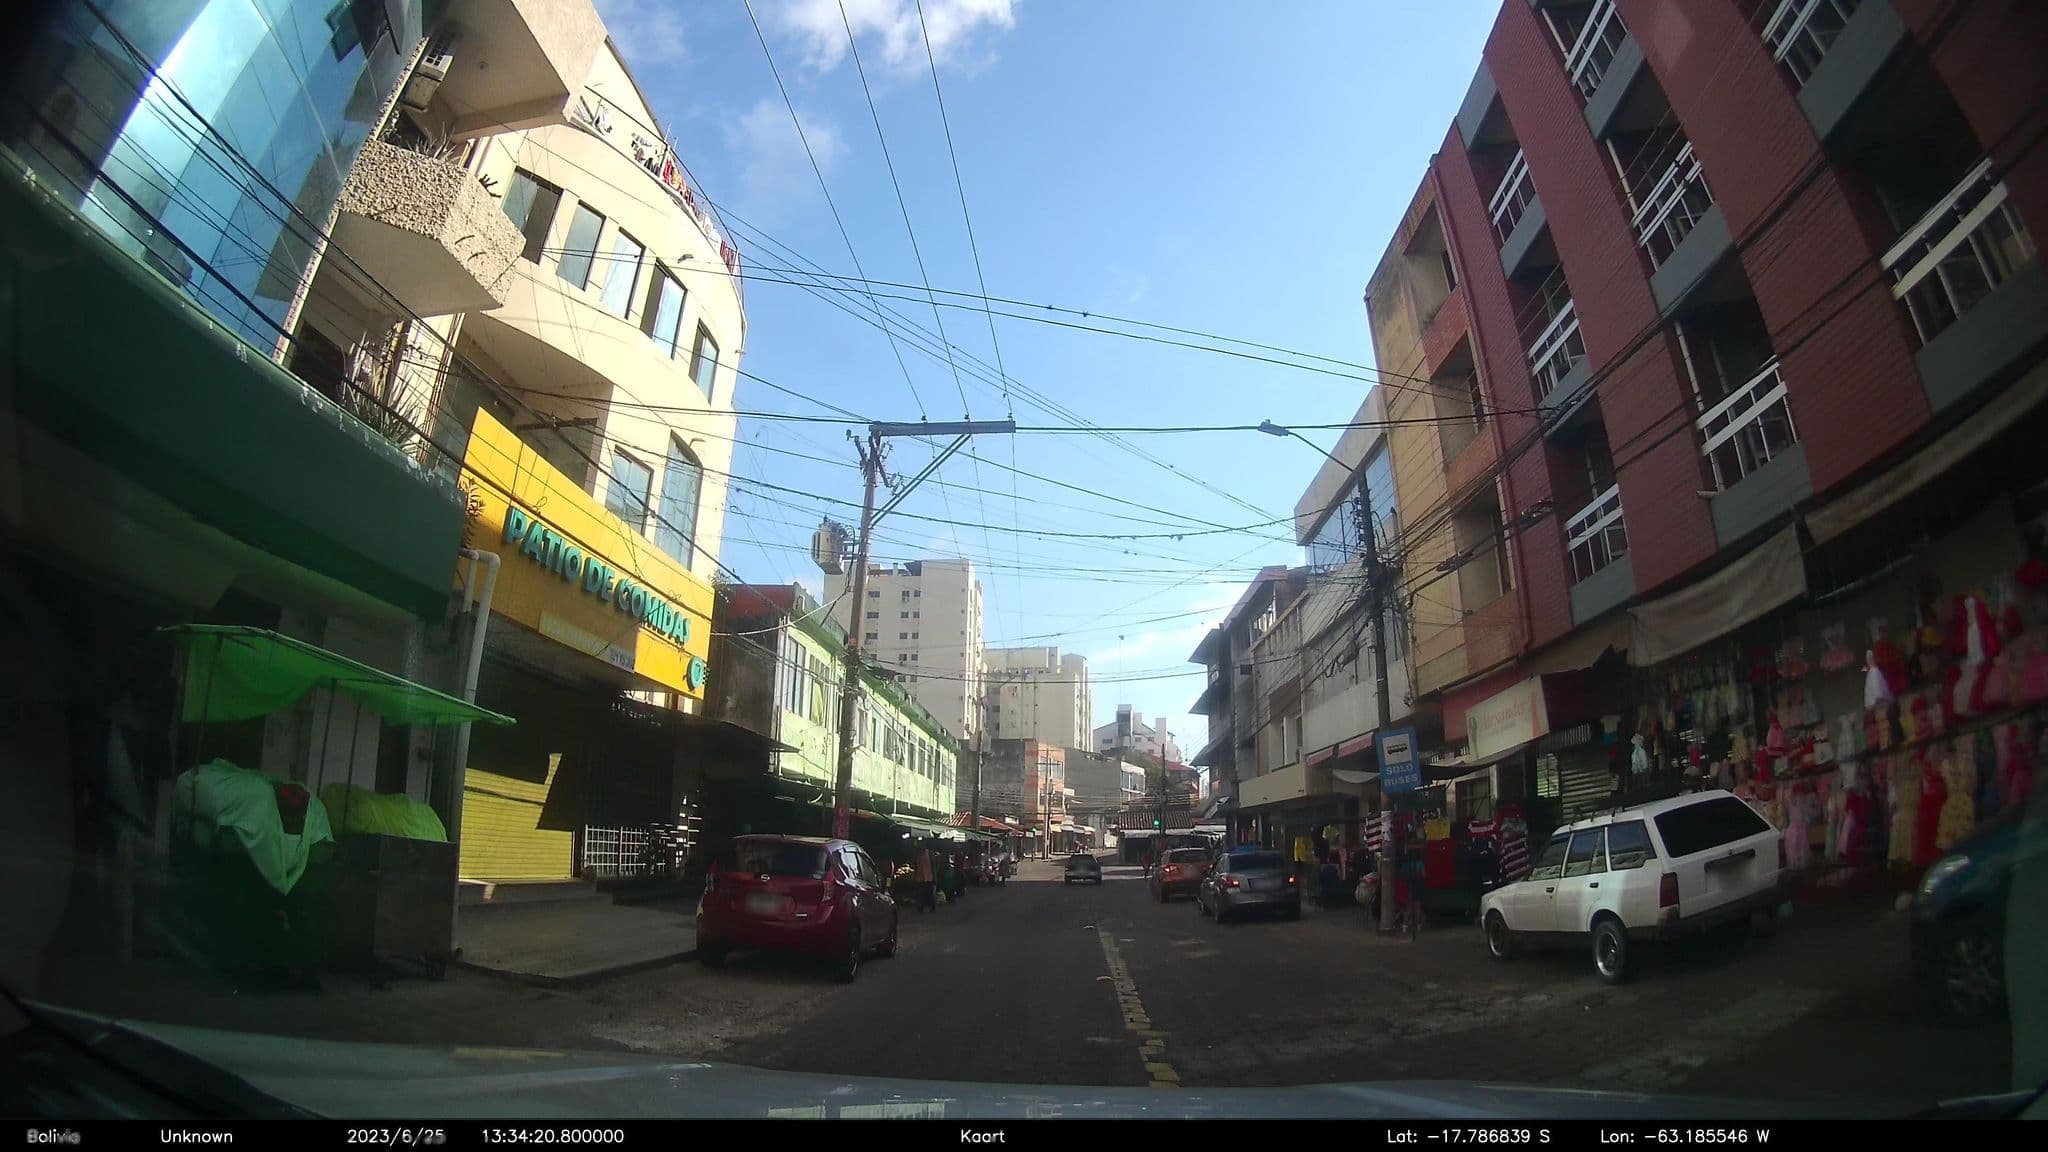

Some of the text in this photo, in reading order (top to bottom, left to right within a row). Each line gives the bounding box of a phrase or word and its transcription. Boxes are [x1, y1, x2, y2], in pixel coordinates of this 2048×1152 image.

[504, 505, 583, 583] PATIO
[582, 556, 615, 602] DE
[614, 577, 691, 645] COMIDAS
[1385, 764, 1413, 776] SOLO
[1383, 774, 1418, 787] BUSES
